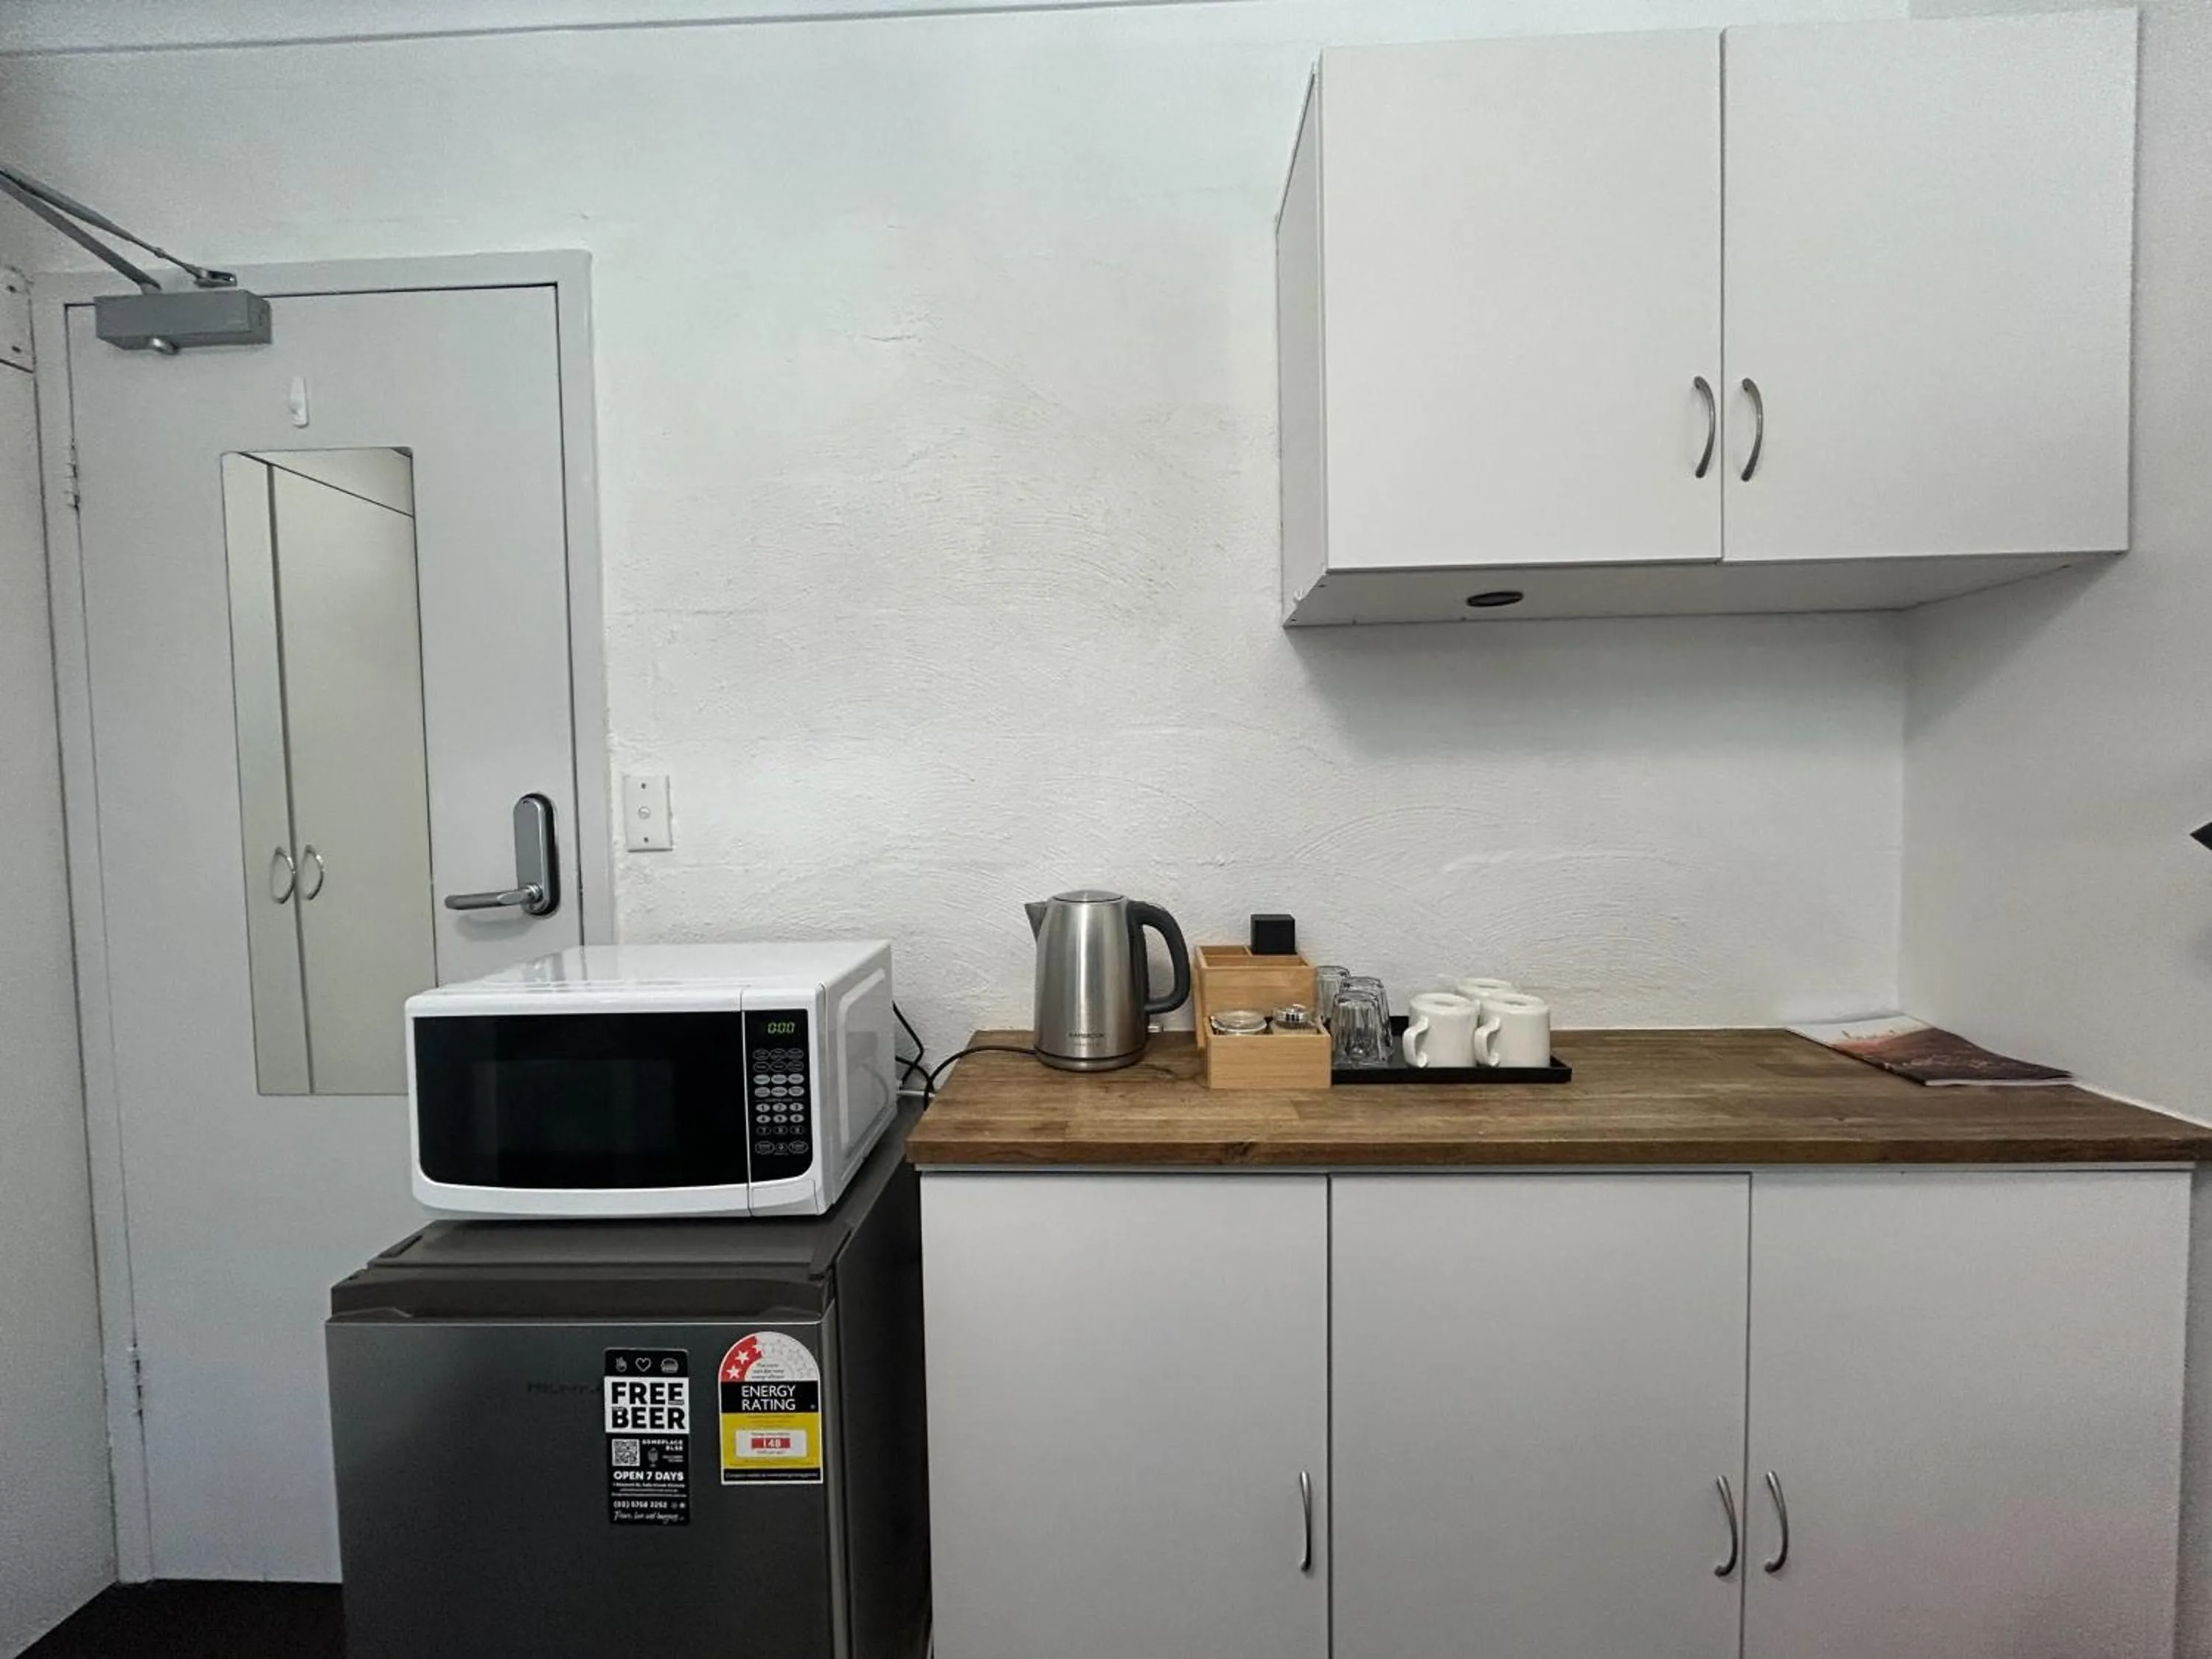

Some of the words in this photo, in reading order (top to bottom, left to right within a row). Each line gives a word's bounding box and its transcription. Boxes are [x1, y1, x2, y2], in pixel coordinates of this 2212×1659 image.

[611, 1381, 684, 1405] FREE
[741, 1385, 796, 1397] ENERGY
[741, 1399, 796, 1411] RATING
[611, 1405, 686, 1429] BEER
[613, 1471, 644, 1480] OPEN
[646, 1471, 653, 1481] 7
[655, 1471, 684, 1481] DAYS
